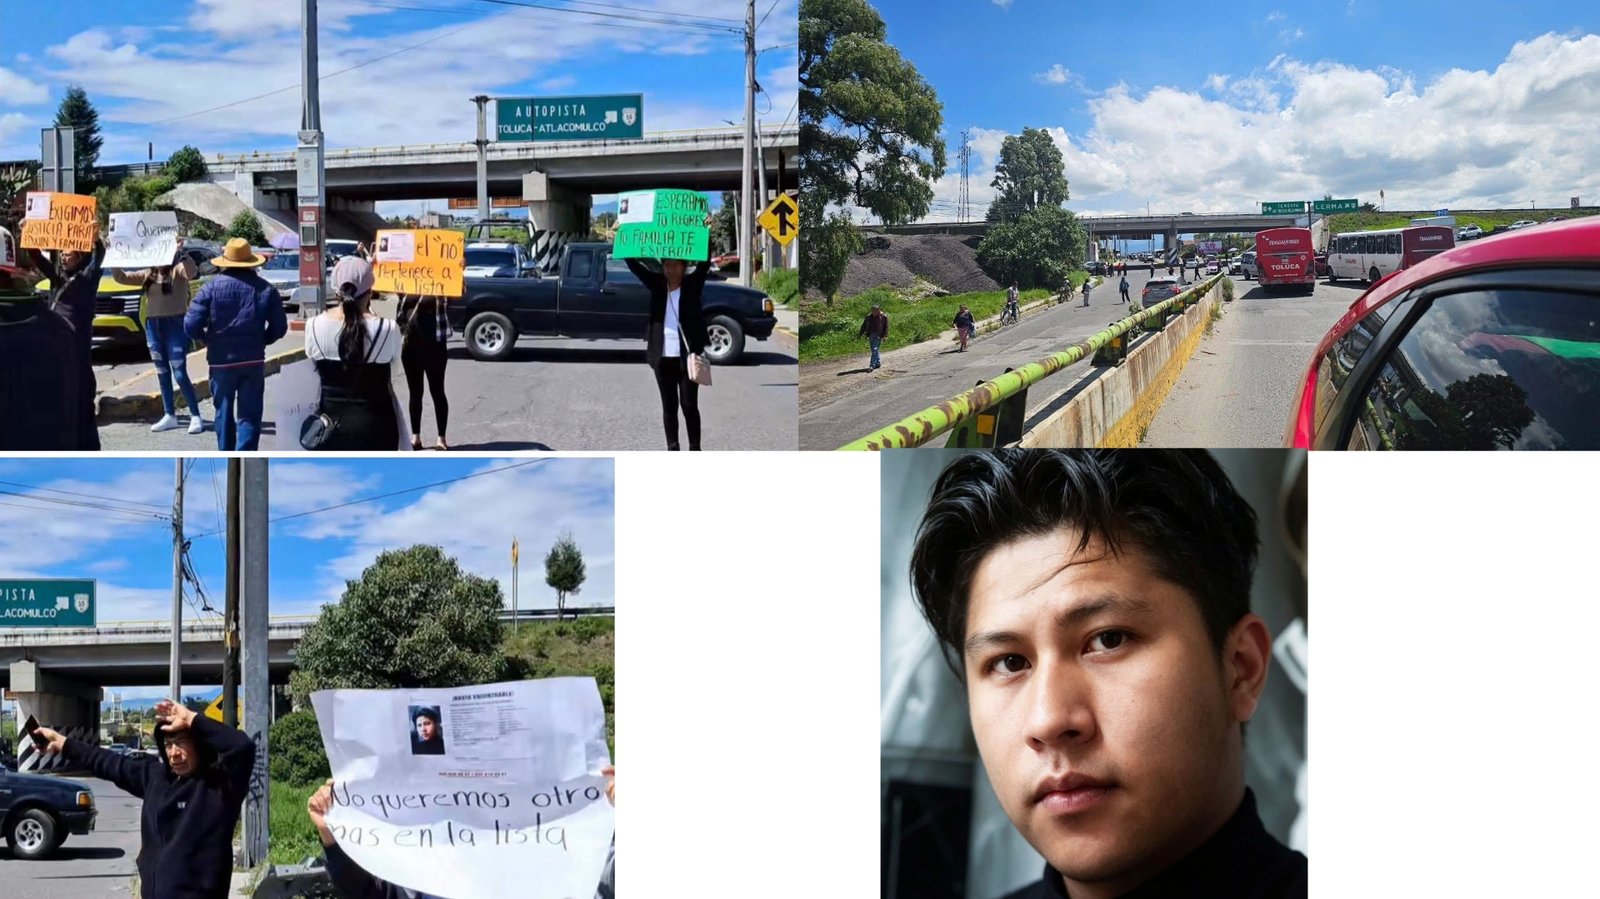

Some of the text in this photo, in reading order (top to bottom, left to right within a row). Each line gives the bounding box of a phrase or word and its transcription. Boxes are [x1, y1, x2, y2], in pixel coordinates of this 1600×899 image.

[515, 104, 586, 118] AUTOPISTA
[498, 122, 606, 133] TOLUCA-ATLACOMULCO
[49, 200, 95, 224] EXIGIMOS
[656, 212, 668, 228] TU
[24, 221, 92, 239] JUSTICIA PARA
[633, 228, 675, 246] FAMILIA
[680, 231, 695, 246] TE
[416, 234, 429, 257] el
[378, 262, 452, 280] Pertenece a
[415, 278, 444, 295] lista
[330, 781, 600, 818] No queremos otro
[394, 828, 433, 848] en
[447, 821, 476, 847] la
[495, 812, 568, 852] lista
